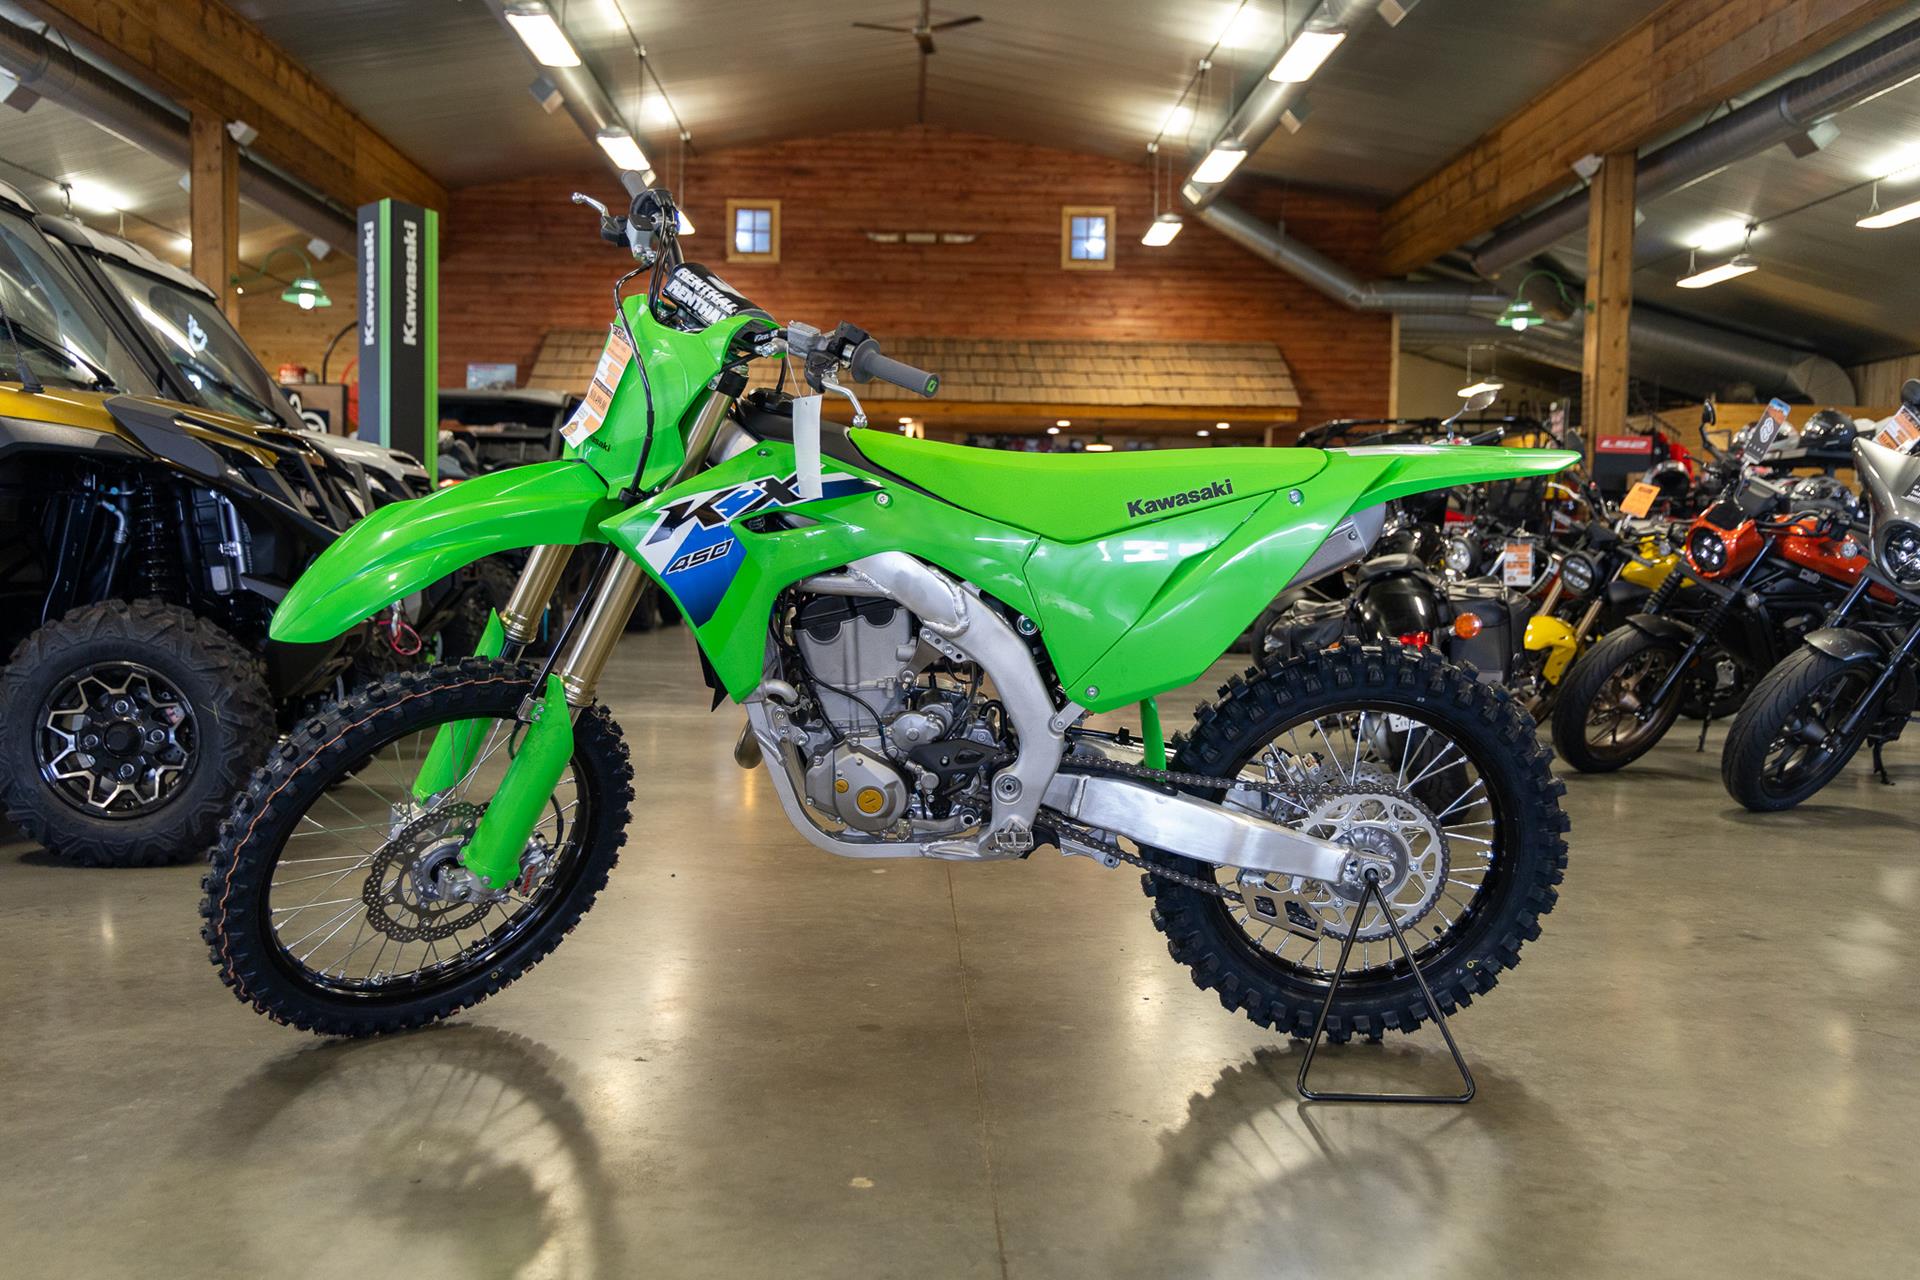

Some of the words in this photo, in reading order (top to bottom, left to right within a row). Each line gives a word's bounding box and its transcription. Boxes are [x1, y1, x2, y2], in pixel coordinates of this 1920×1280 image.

[363, 220, 375, 346] Kawasaki
[403, 219, 417, 346] Kawasaki
[665, 279, 728, 324] RENTHA
[674, 267, 739, 315] RENTHAL
[645, 472, 809, 546] KX
[1126, 478, 1233, 518] Kawasaki
[667, 539, 734, 575] 450
